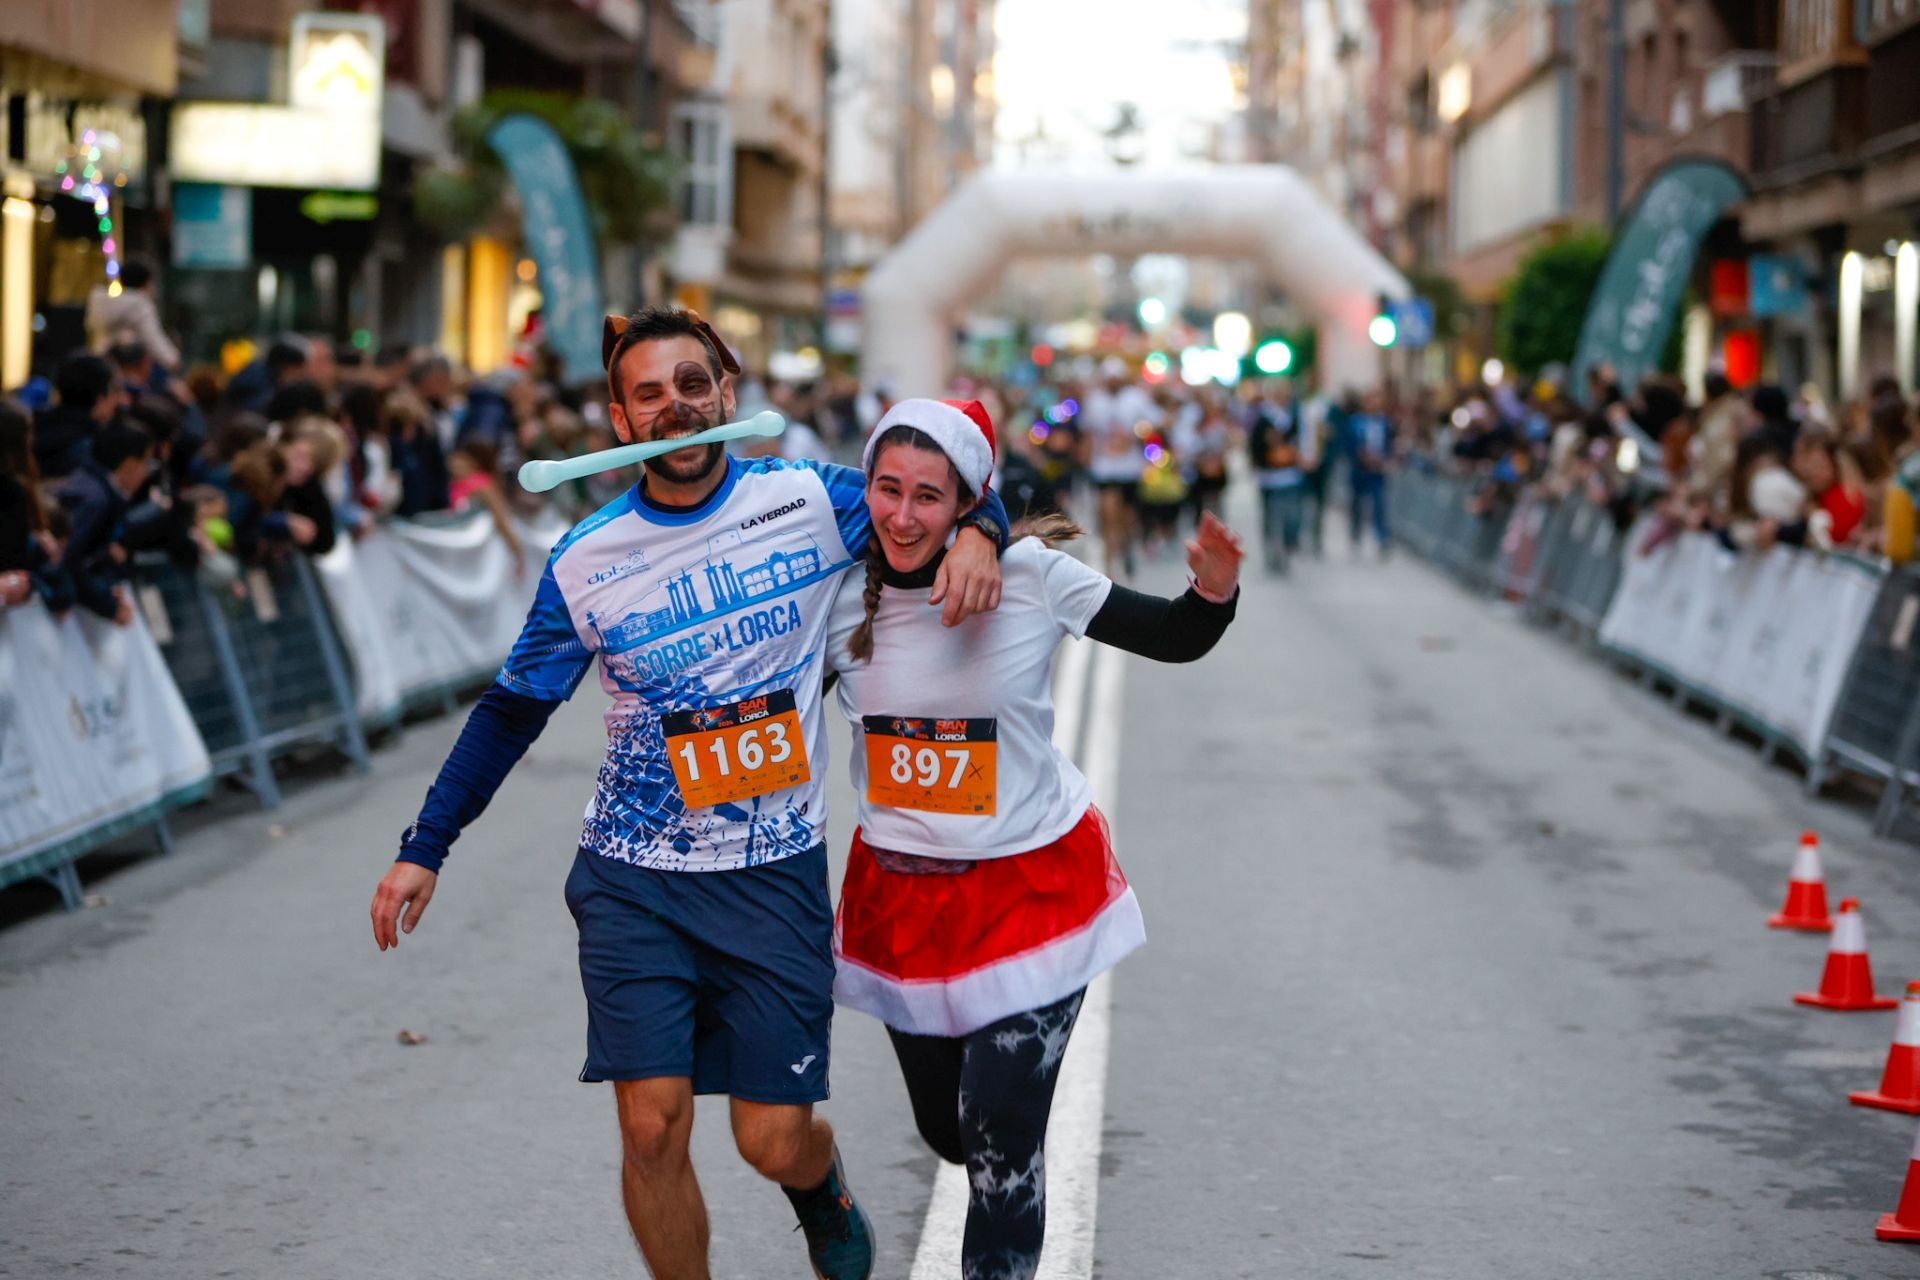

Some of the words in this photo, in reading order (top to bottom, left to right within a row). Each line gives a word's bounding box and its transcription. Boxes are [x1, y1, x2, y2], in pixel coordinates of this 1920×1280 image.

[741, 516, 758, 530] LA
[757, 497, 806, 525] VERDAD
[633, 632, 713, 682] CORRE
[722, 599, 801, 651] LORCA
[738, 696, 768, 713] SAN
[739, 709, 770, 723] LORCA
[935, 719, 968, 731] SAN
[935, 733, 967, 742] LORCA
[679, 720, 792, 782] 1163
[889, 742, 971, 790] 897
